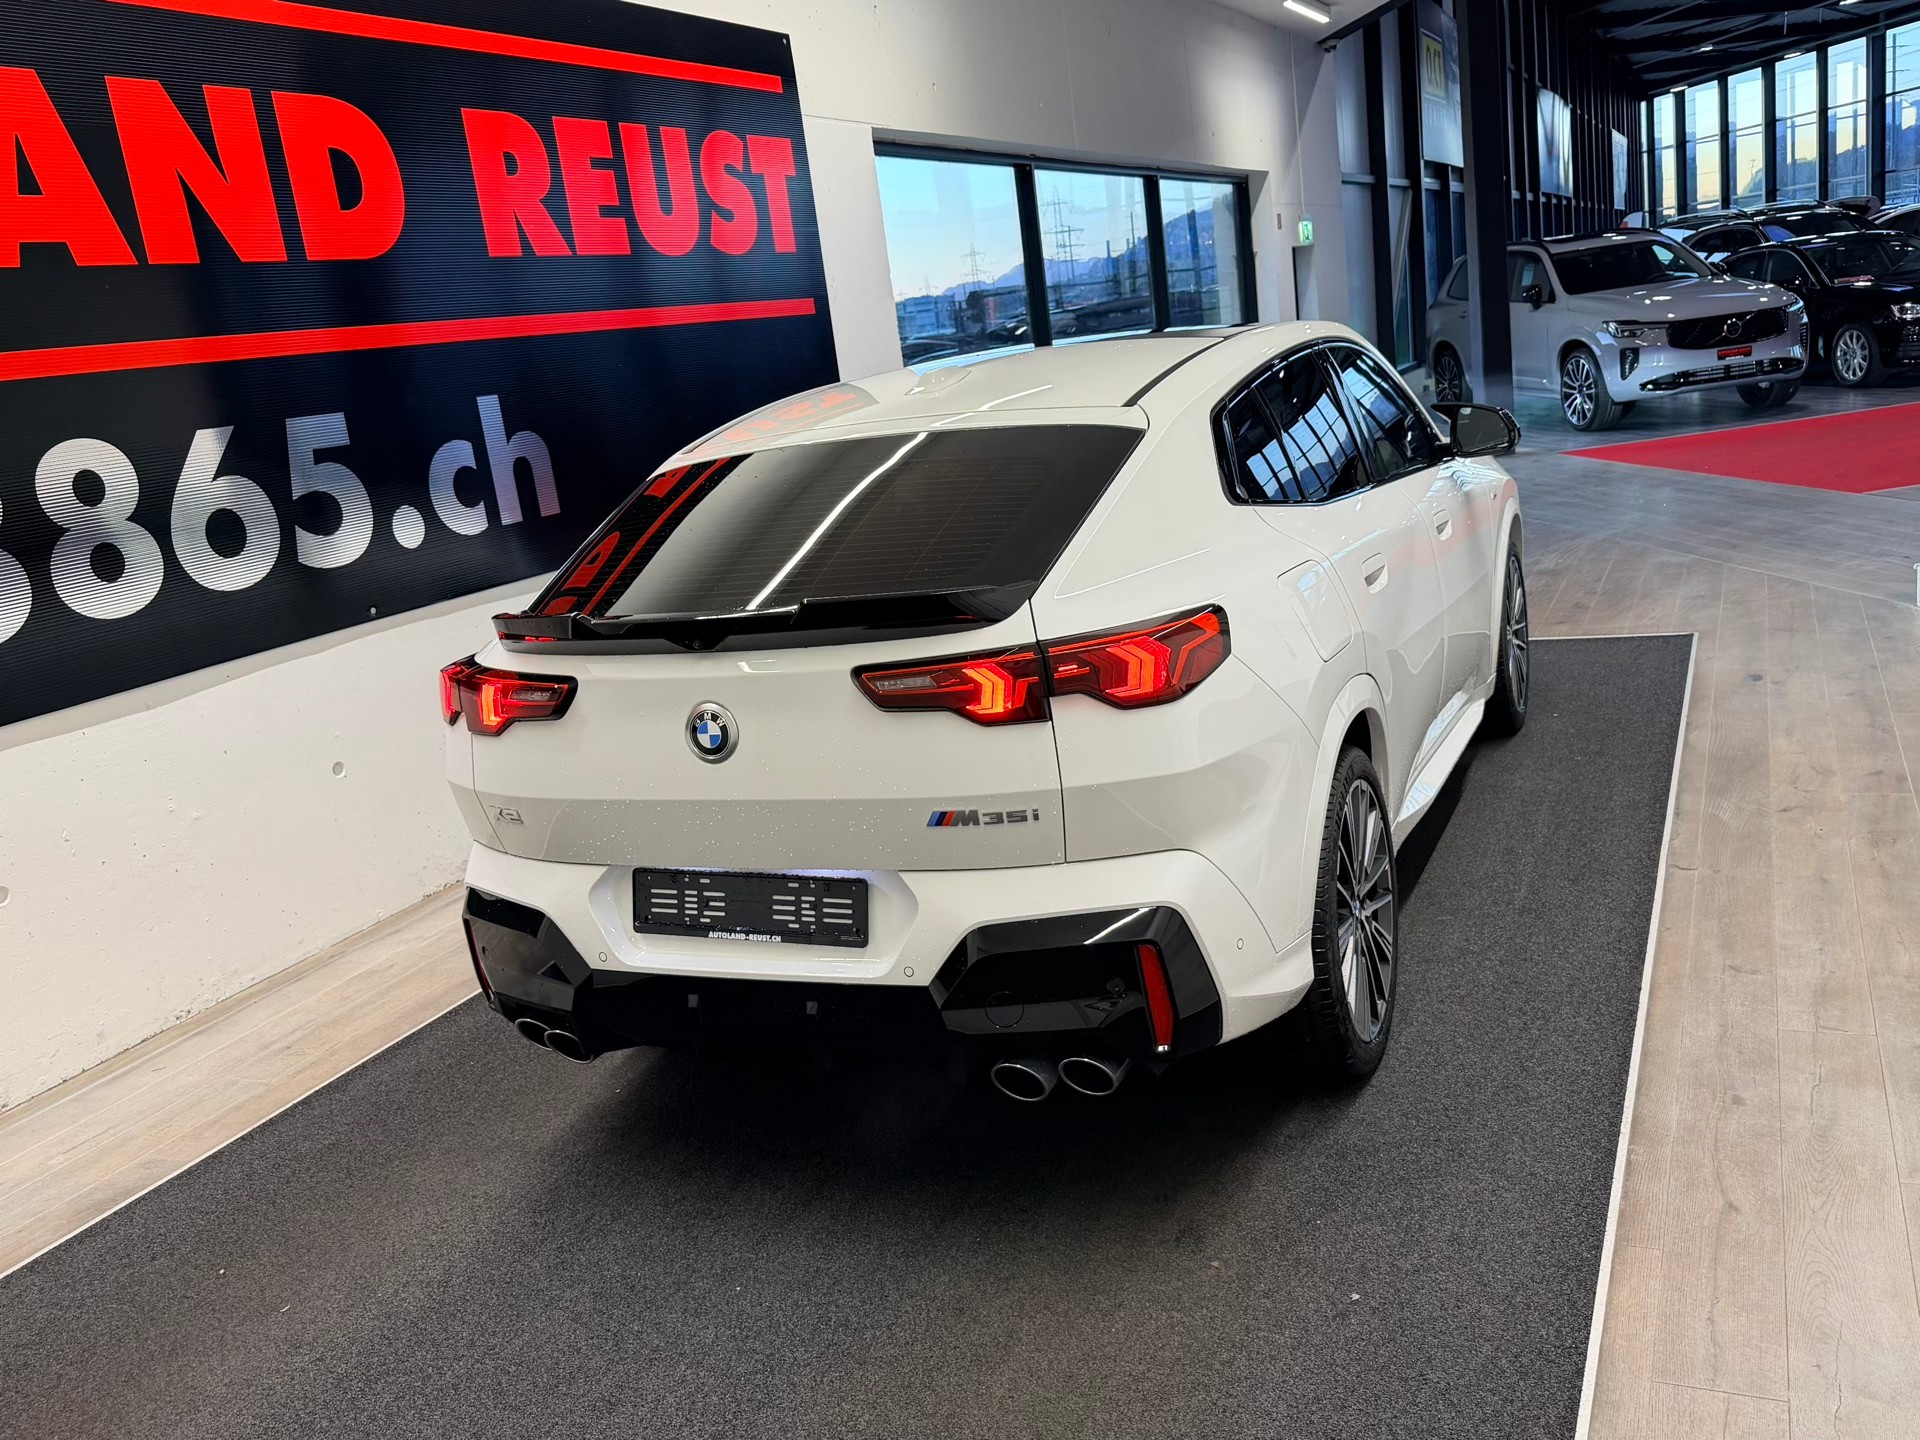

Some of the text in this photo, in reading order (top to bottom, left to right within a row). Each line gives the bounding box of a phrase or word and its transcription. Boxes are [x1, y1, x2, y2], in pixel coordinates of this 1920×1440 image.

[0, 66, 797, 267] AND REUST
[0, 395, 561, 643] 865.ch
[694, 712, 725, 727] BMW
[948, 808, 1040, 827] M35i
[708, 931, 782, 943] AUTOLAND-REUST.CH
